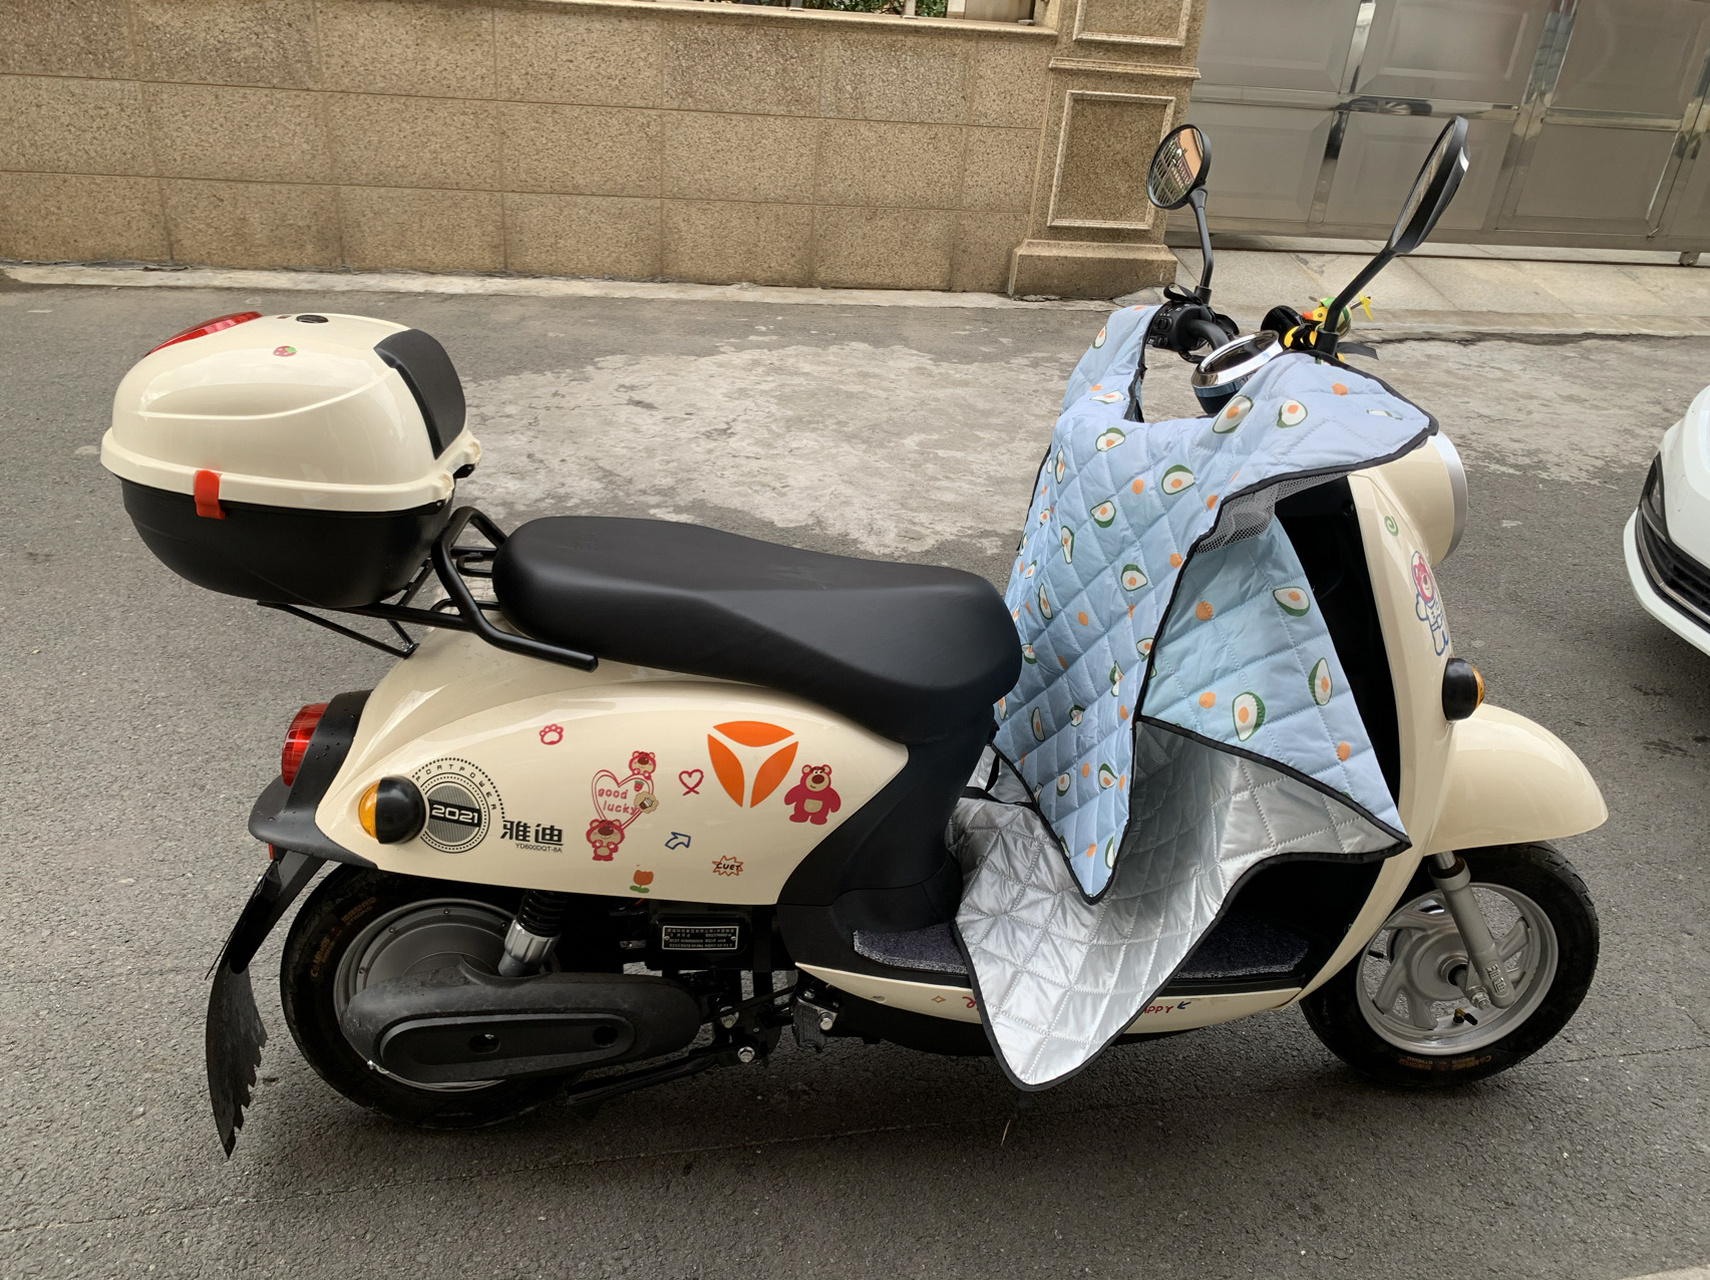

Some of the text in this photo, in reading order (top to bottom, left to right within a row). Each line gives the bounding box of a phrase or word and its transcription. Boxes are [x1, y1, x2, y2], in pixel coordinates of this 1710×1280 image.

[598, 788, 628, 800] good
[431, 804, 479, 824] 2021
[603, 800, 638, 816] lucky
[500, 820, 563, 846] 雅迪
